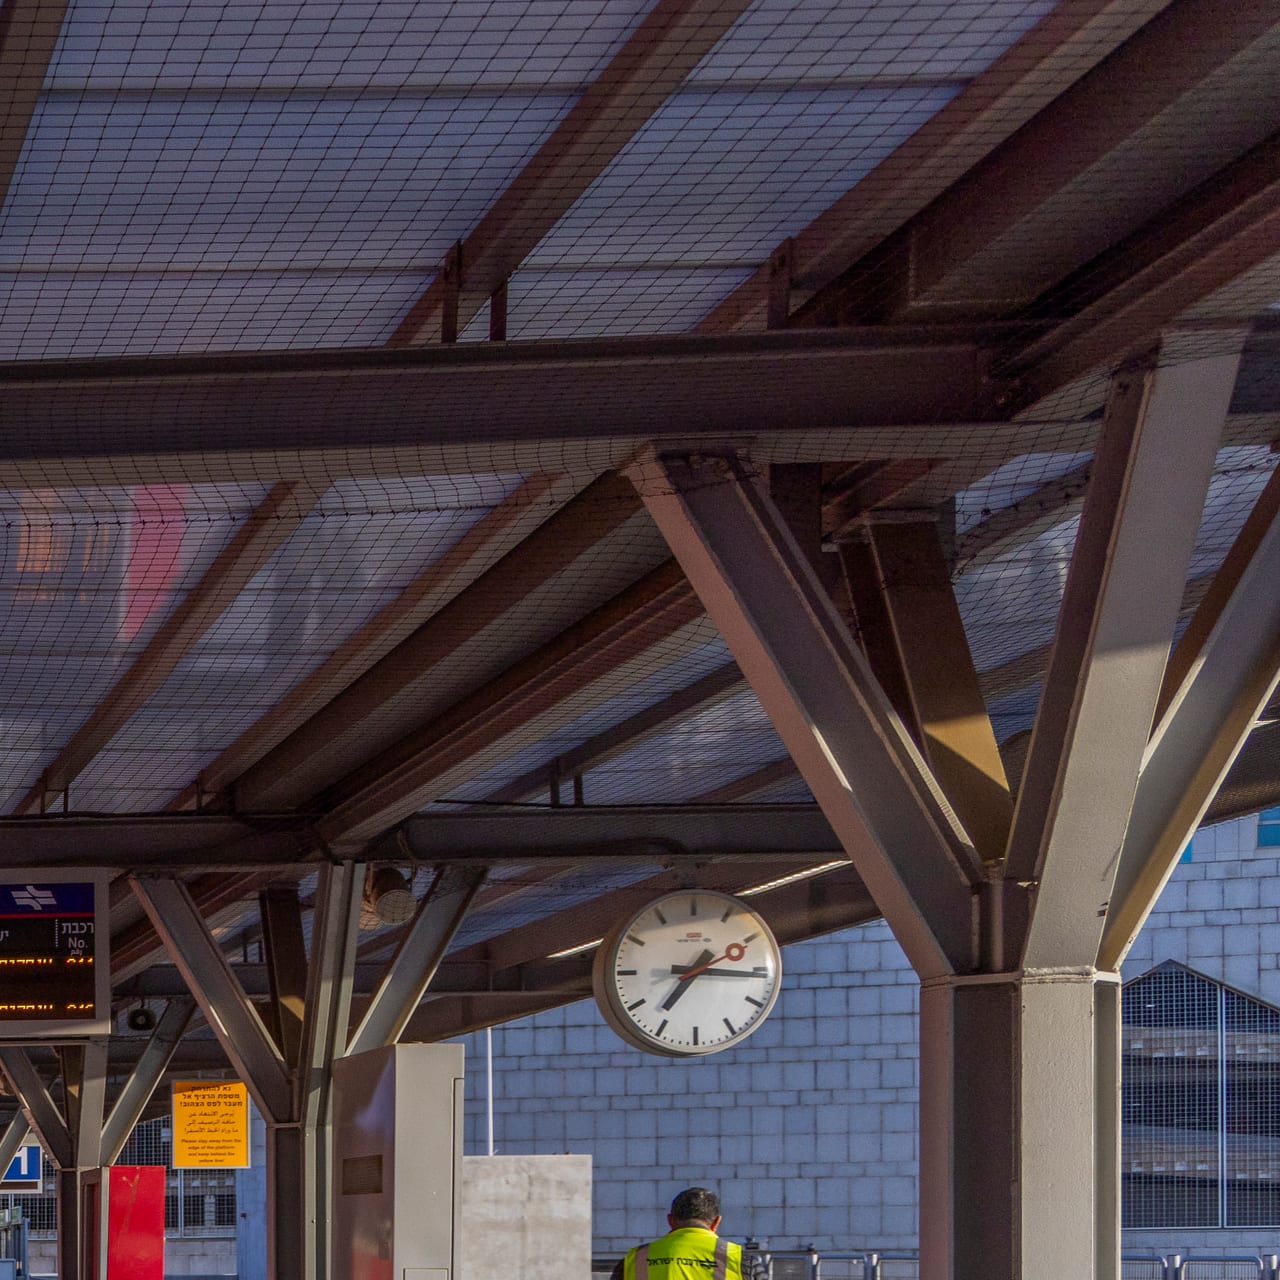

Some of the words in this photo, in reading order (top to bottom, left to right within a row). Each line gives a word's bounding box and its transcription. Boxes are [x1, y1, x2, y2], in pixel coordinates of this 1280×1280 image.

[62, 922, 94, 934] רכבת
[68, 937, 88, 948] No.
[14, 1146, 28, 1175] 1
